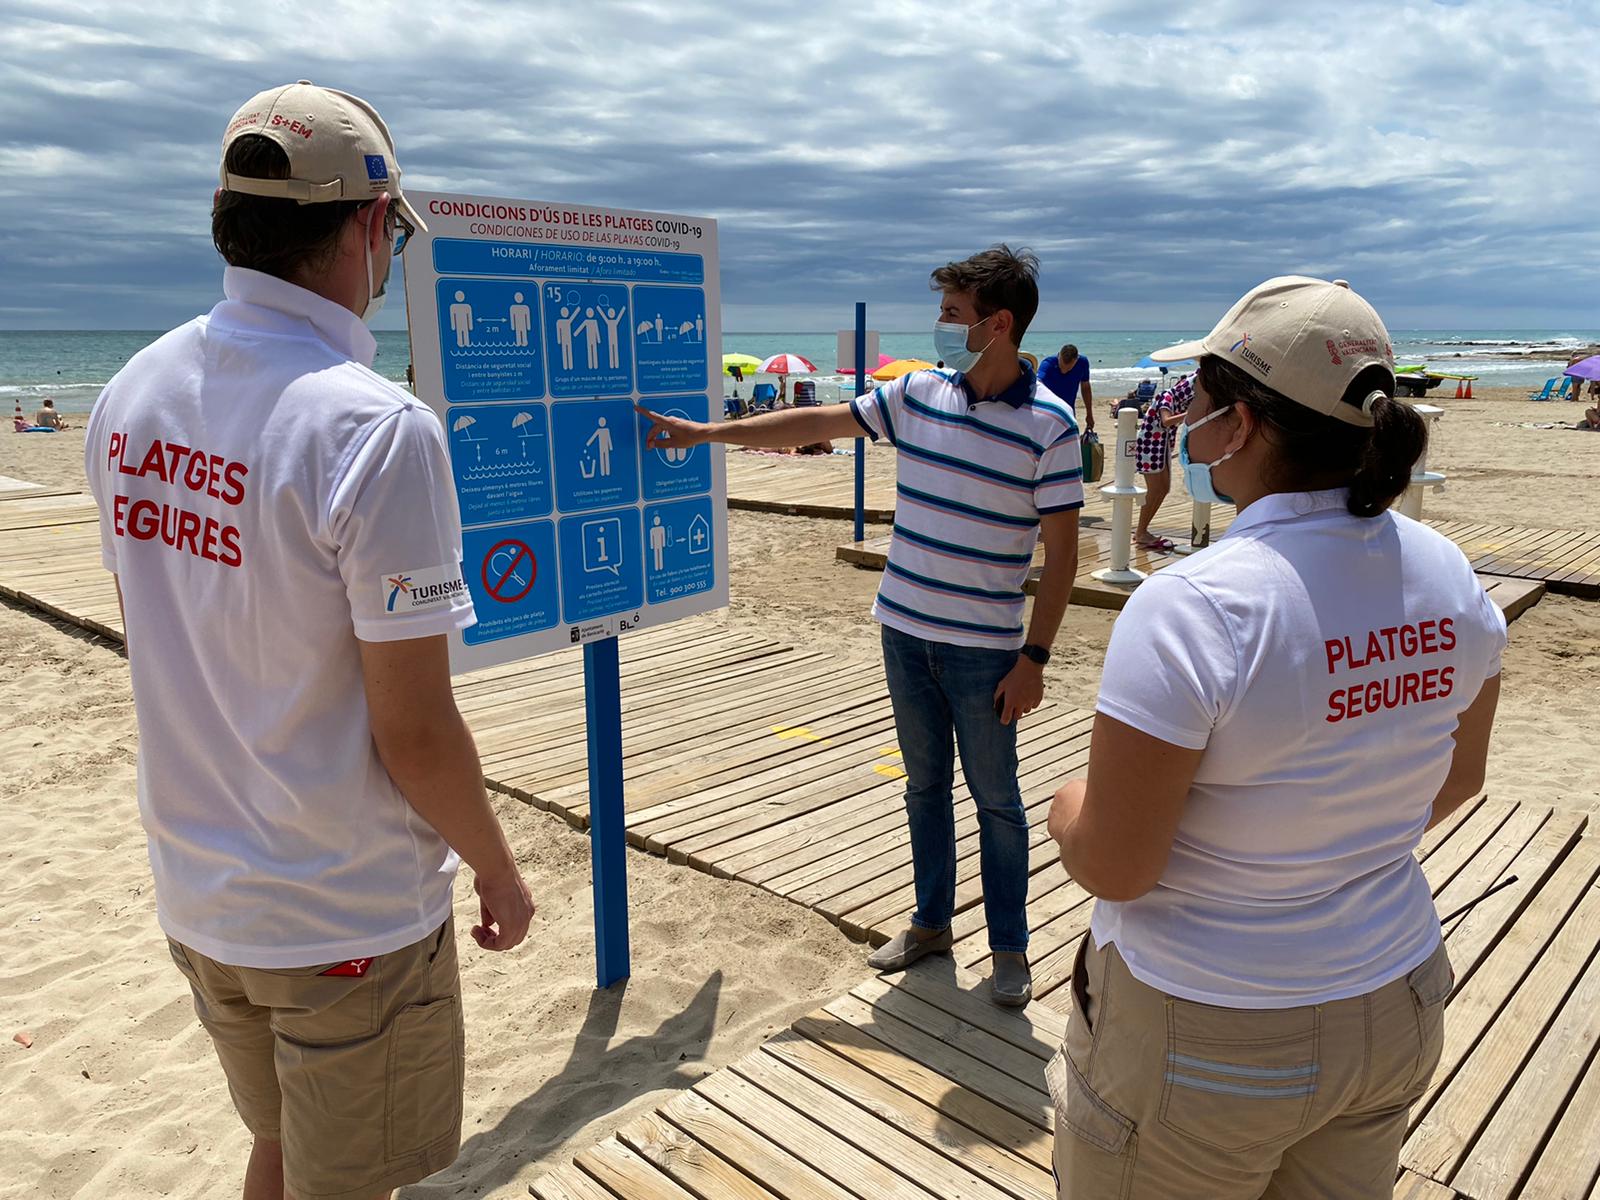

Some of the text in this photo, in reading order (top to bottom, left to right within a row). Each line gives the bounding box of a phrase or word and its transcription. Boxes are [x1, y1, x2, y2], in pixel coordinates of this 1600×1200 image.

[271, 114, 313, 139] S+EM
[429, 200, 702, 239] CONDICIONS D'ÚS DE LES PLATGES COVID-19
[470, 223, 680, 251] CONDICIONES DE USO DE LAS PLAYAS COVID-19
[491, 247, 532, 259] HORARI
[541, 250, 585, 262] HORARIO:
[586, 252, 597, 263] de
[598, 255, 617, 268] 9:00
[618, 254, 626, 265] h.
[633, 257, 653, 267] 19:00
[653, 256, 661, 267] h.
[529, 263, 566, 273] Aforament
[567, 264, 589, 274] limitat
[547, 287, 562, 303] 15
[1242, 347, 1272, 374] TURISME
[108, 432, 249, 505] PLATGES
[113, 495, 242, 567] EGURES
[410, 579, 463, 600] TURISME
[669, 585, 683, 596] 900
[1325, 617, 1457, 674] PLATGES
[1325, 666, 1455, 723] SEGURES
